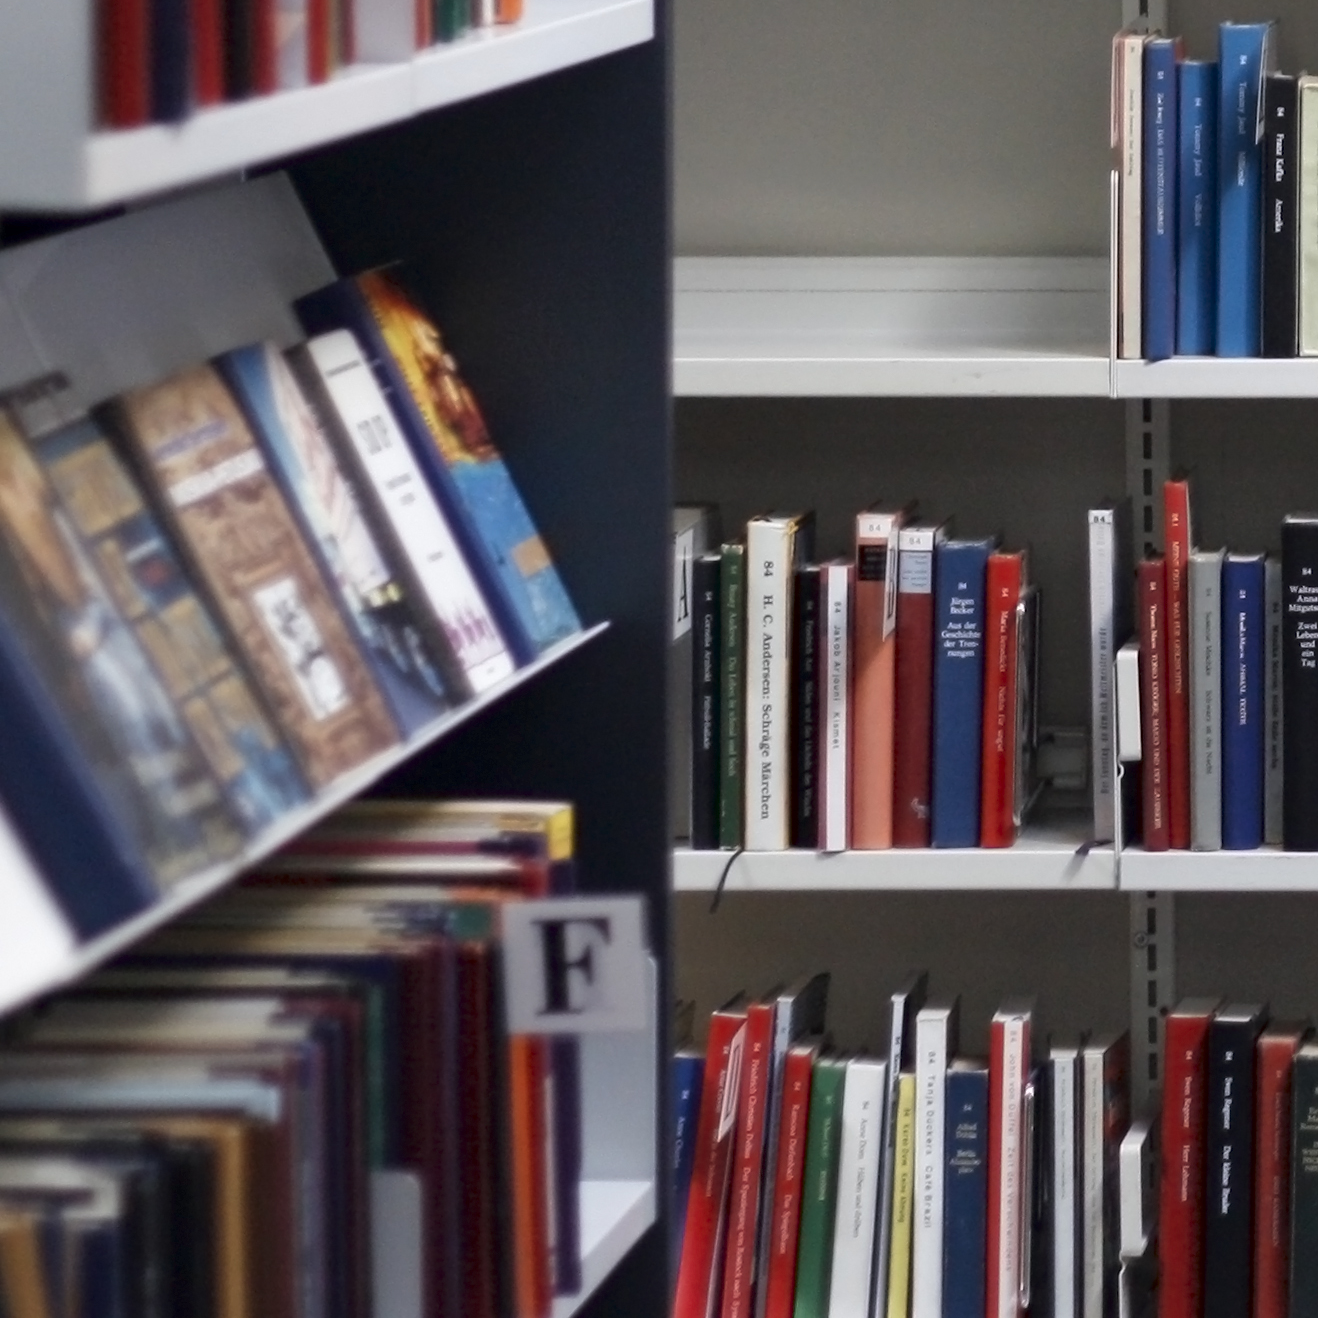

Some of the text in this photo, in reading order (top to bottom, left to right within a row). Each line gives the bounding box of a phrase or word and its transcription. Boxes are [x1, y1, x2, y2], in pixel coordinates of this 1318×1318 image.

[759, 560, 774, 820] 84 H. C. Andersen: Schräge Märchen
[531, 916, 612, 1017] F
[925, 1075, 935, 1105] Tanja
